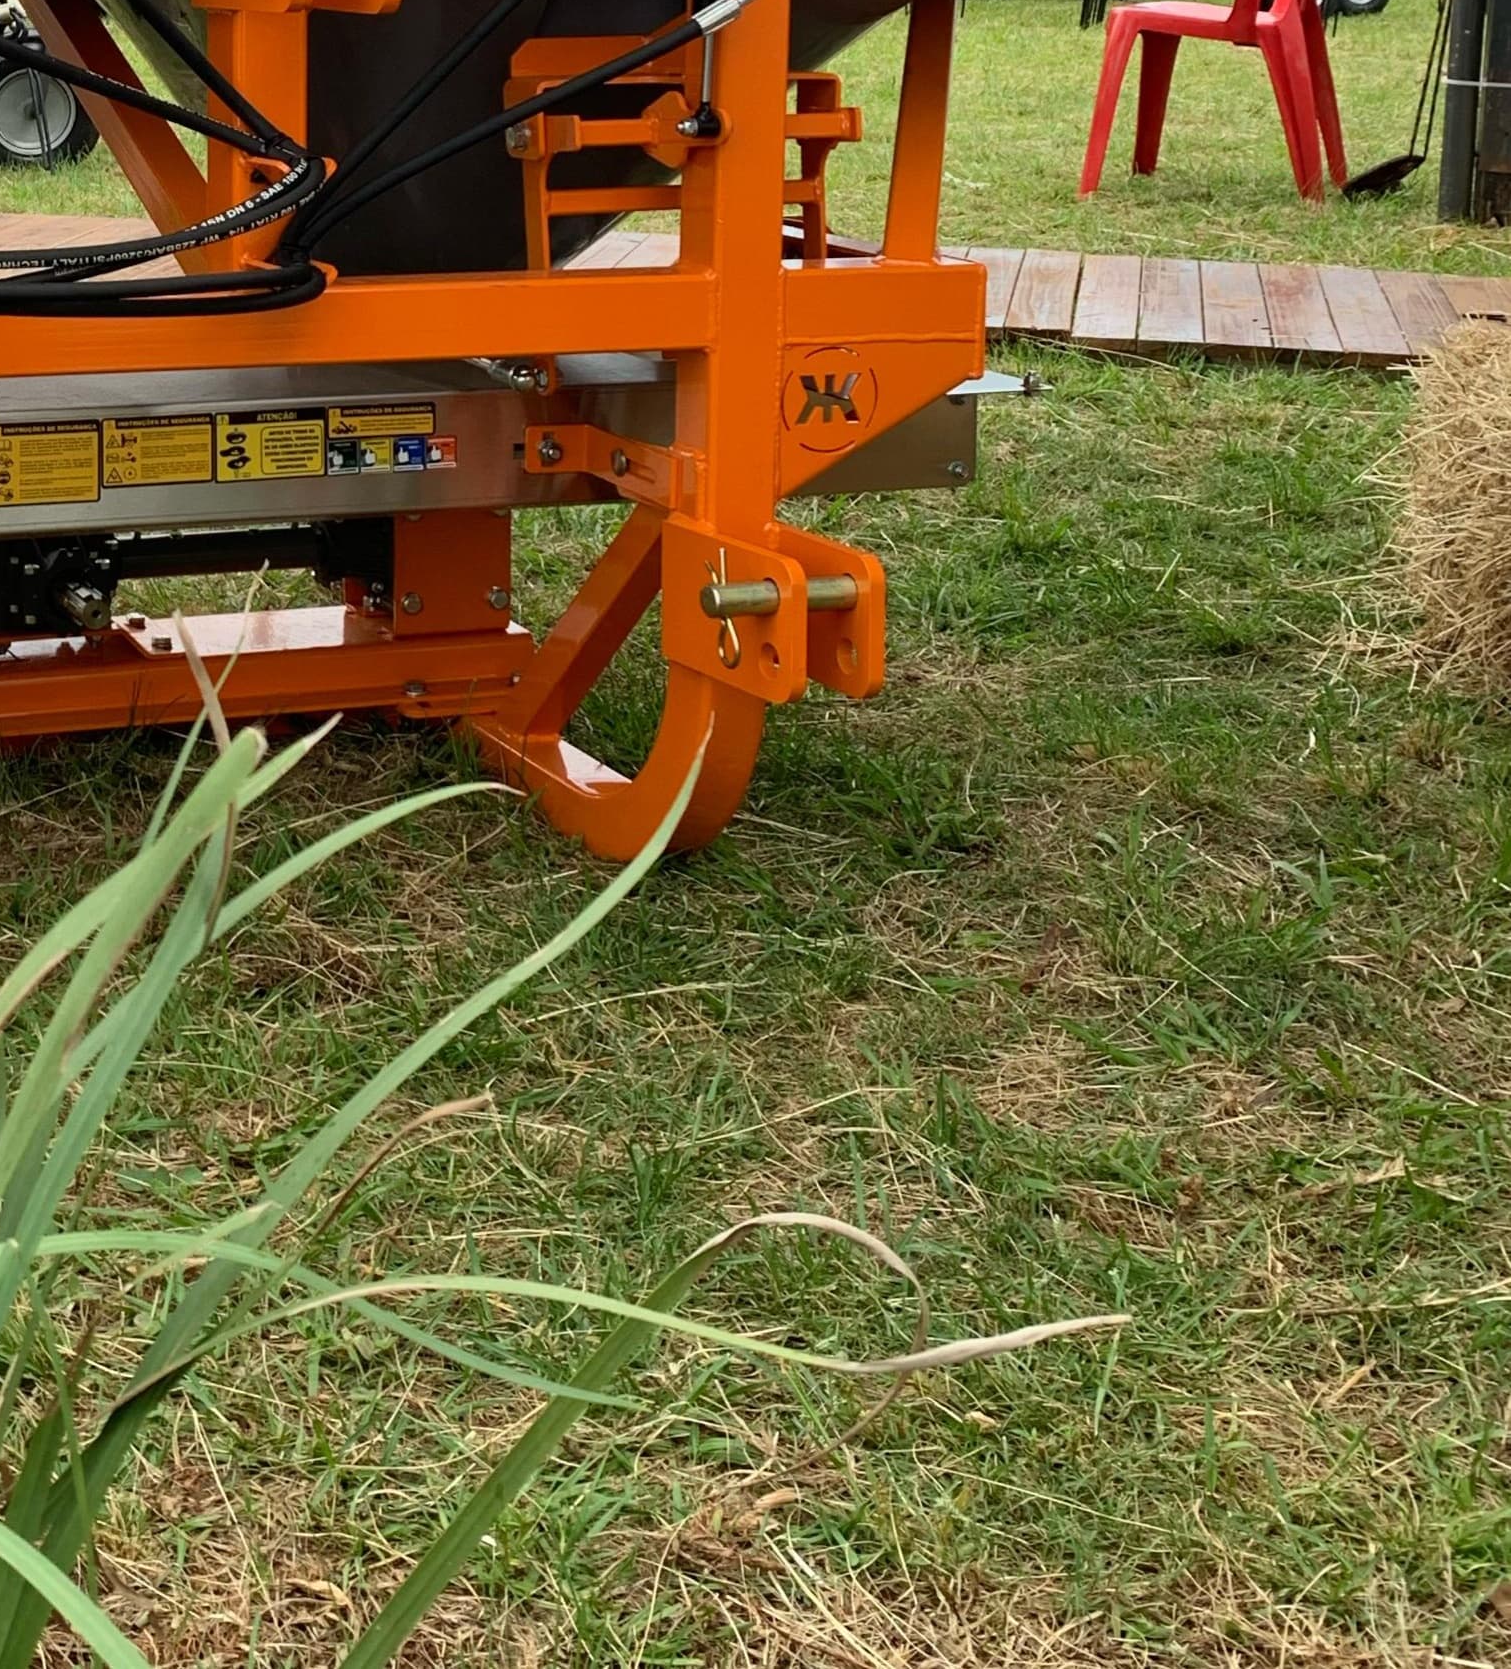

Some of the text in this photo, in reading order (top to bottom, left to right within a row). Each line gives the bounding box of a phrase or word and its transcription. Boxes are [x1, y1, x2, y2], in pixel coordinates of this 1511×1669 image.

[226, 204, 245, 219] DN
[260, 182, 284, 200] SAE
[282, 171, 299, 185] 100
